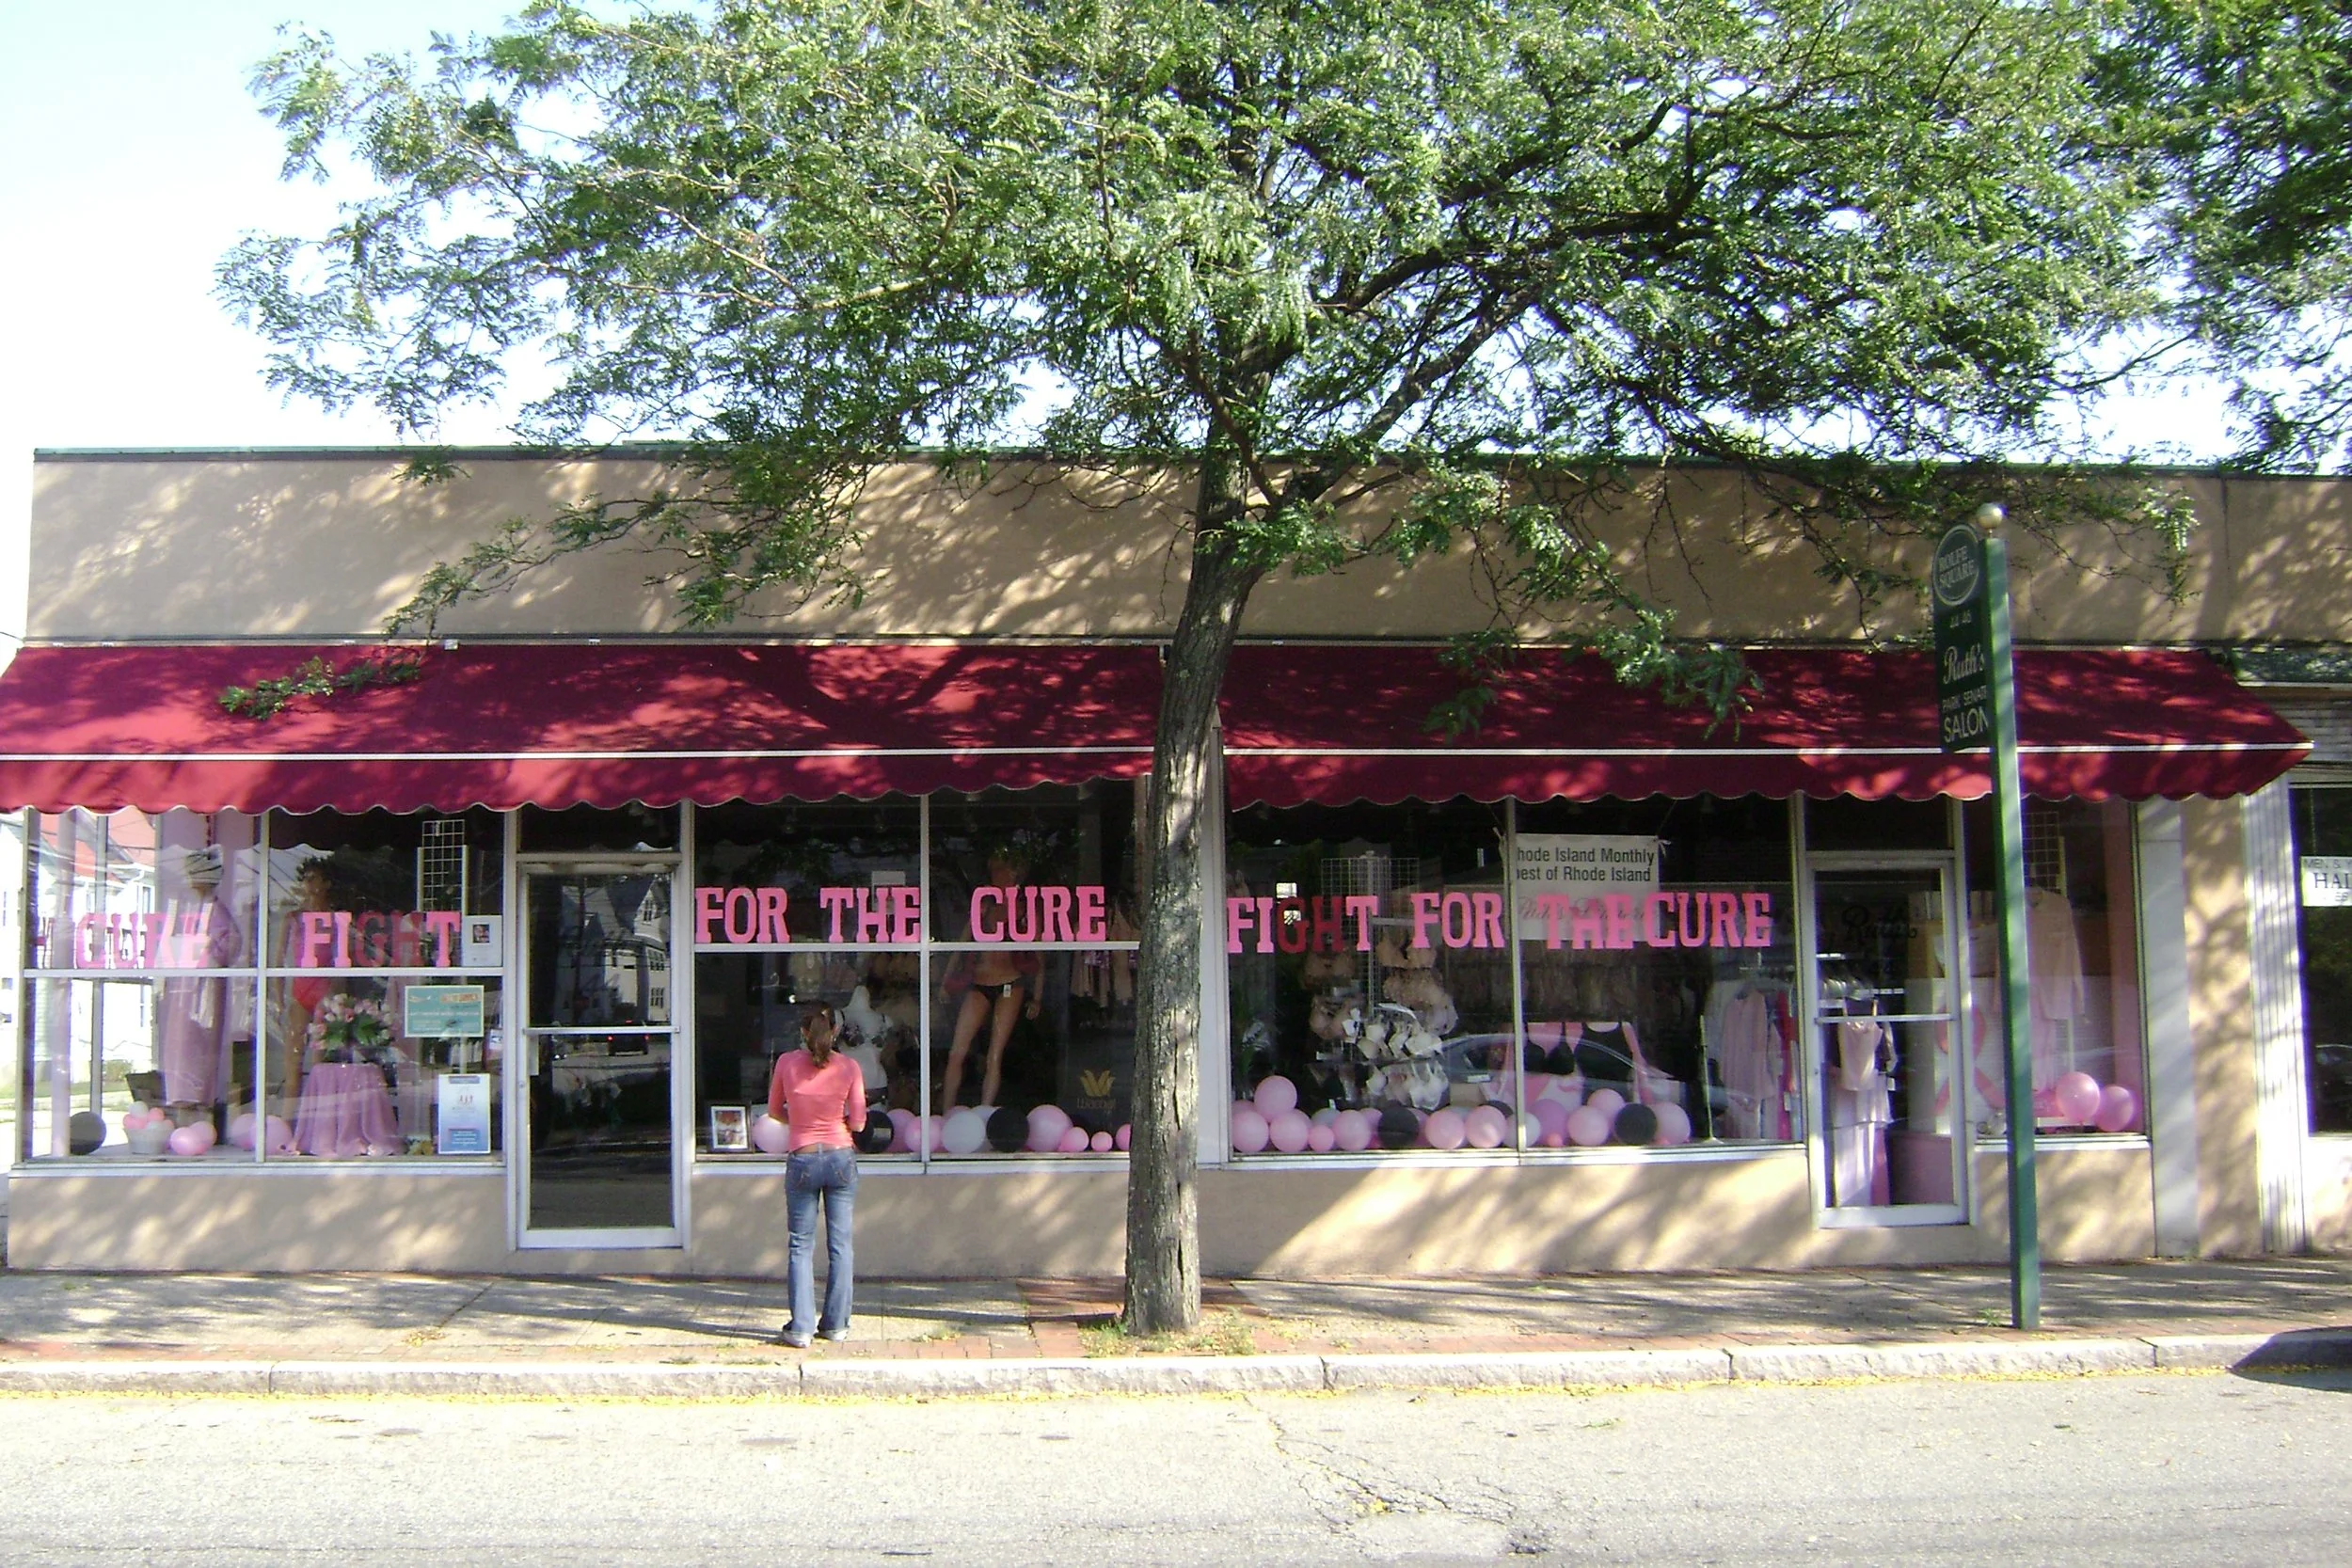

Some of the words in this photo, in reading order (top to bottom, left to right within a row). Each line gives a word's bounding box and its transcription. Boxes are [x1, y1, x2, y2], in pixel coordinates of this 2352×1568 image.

[1938, 560, 1975, 589] SQUARE
[1943, 642, 1985, 685] Ruth's
[1944, 706, 1989, 743] SALON
[1546, 867, 1558, 881] of
[1563, 866, 1606, 881] Rhode
[1555, 848, 1595, 863] Island
[1600, 848, 1654, 866] Monthly
[694, 886, 790, 943] FOR
[819, 886, 921, 943] THE
[970, 886, 1106, 942] CURE
[1226, 895, 1378, 954] FIGHT
[1411, 892, 1505, 949] FOR
[1536, 893, 1635, 950] THE
[1645, 892, 1772, 948] CURE
[301, 911, 461, 968] FIGHT
